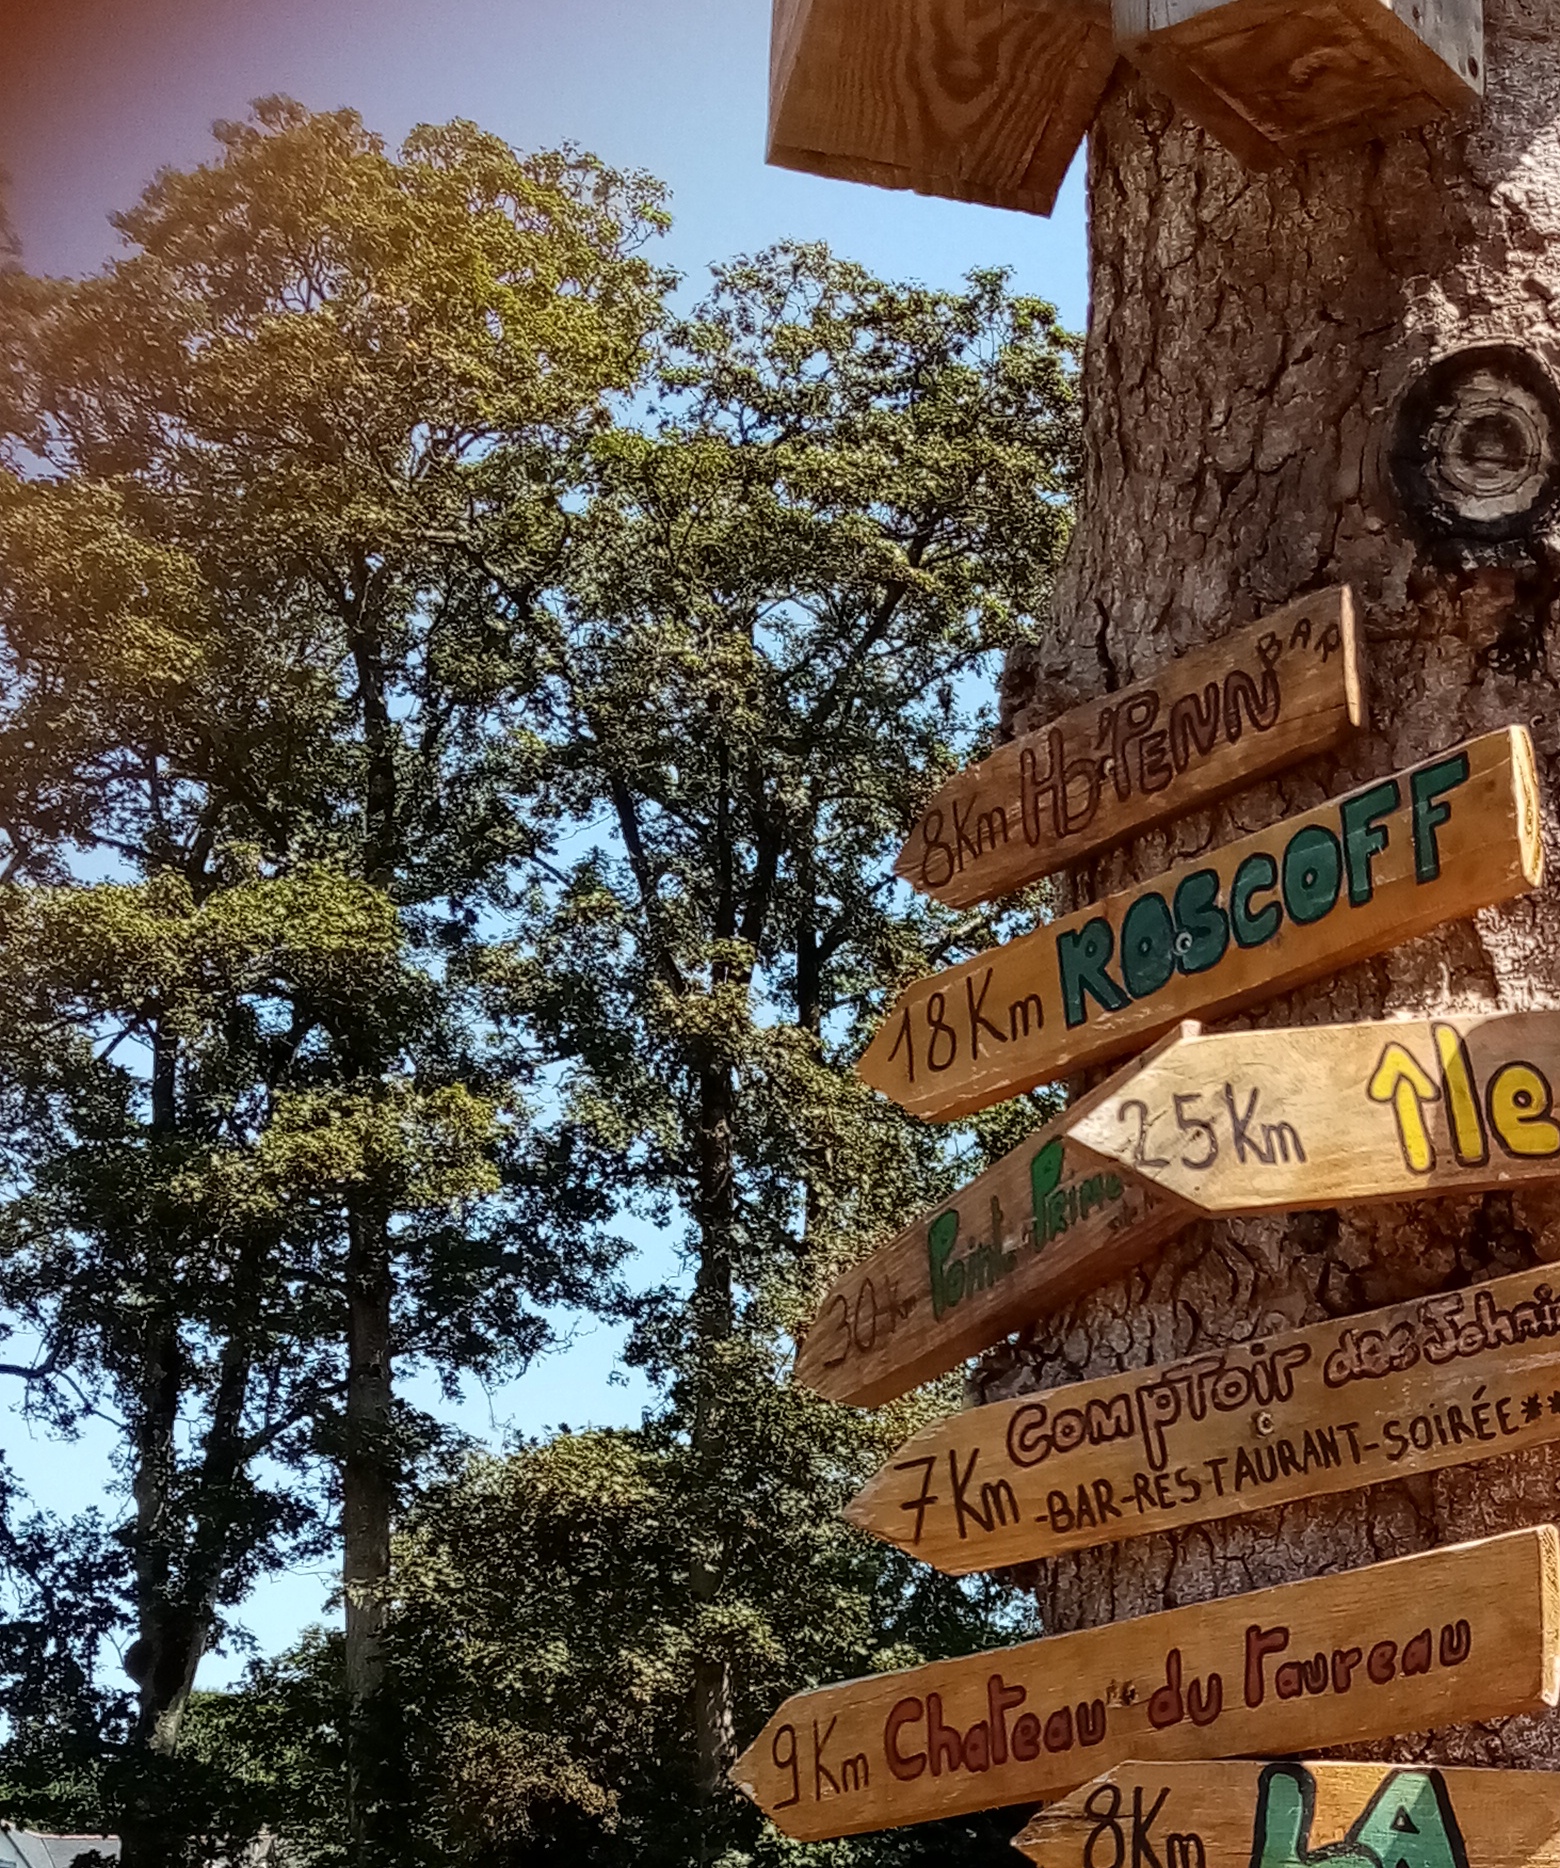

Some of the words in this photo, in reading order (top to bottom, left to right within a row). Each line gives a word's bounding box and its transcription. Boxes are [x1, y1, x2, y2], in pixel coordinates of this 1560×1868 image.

[1056, 750, 1471, 1030] ROSCOFF
[883, 1673, 1107, 1782] Chateau
[1147, 1648, 1224, 1730] du
